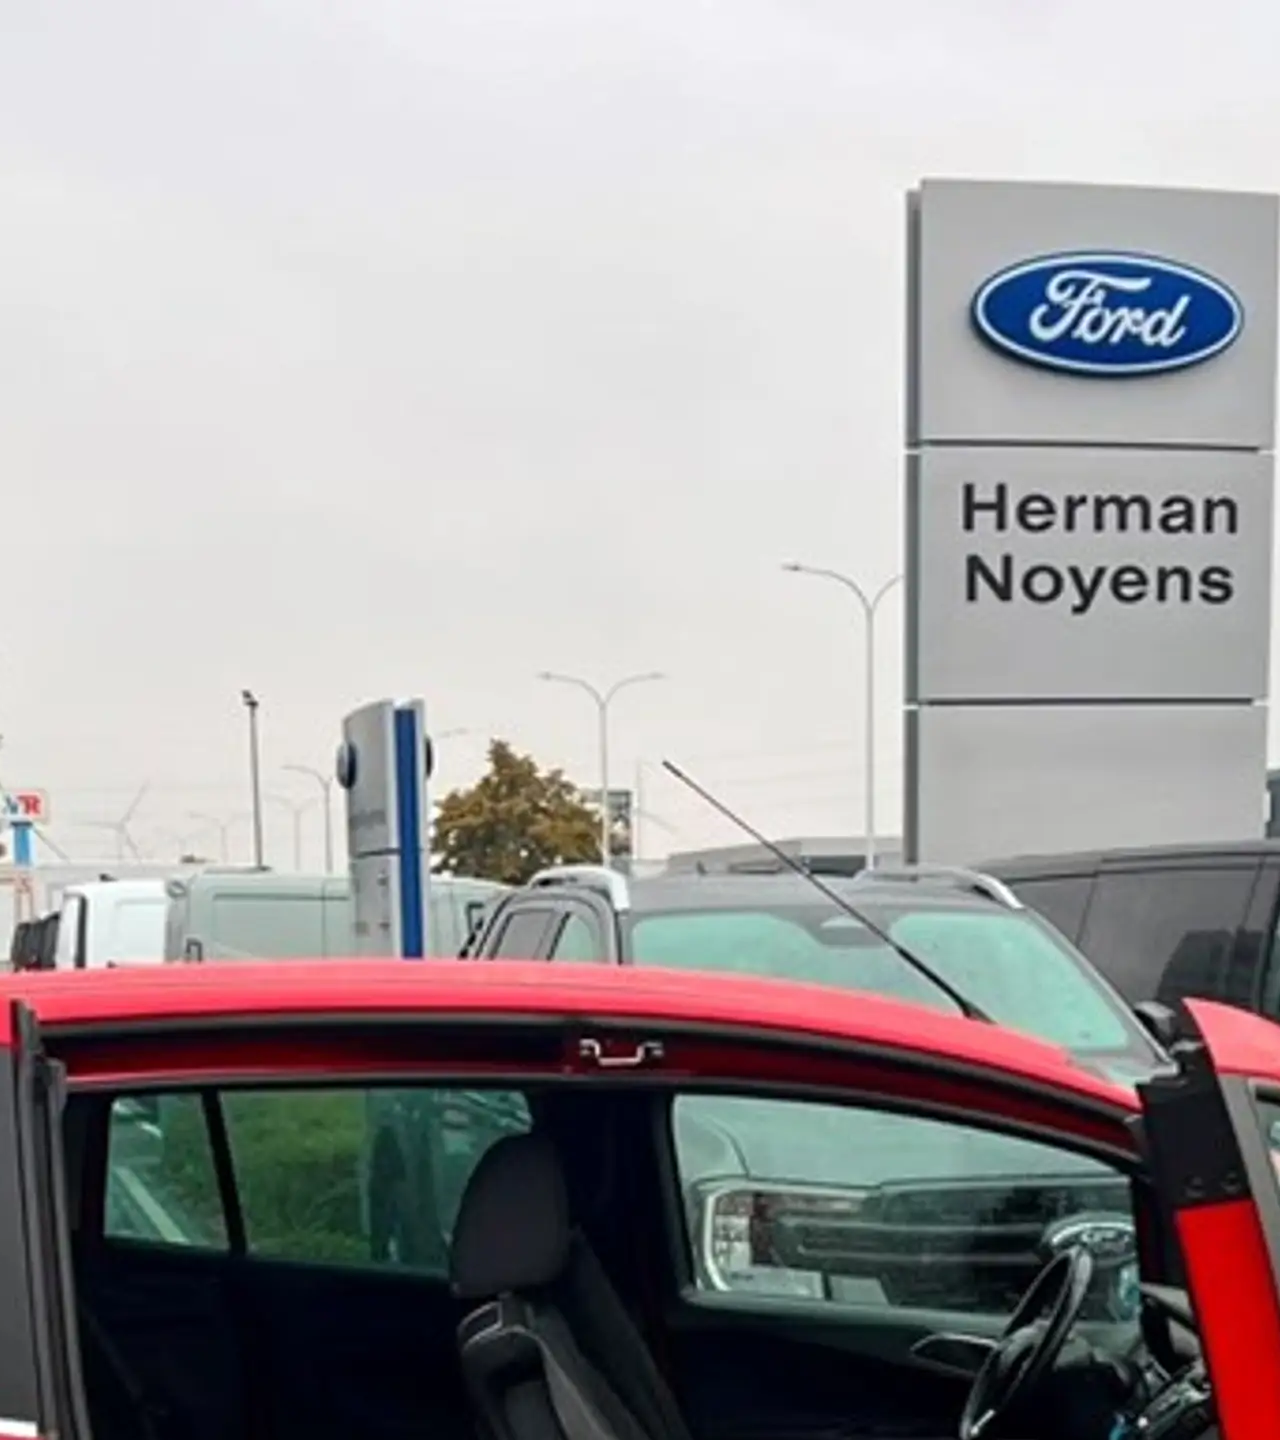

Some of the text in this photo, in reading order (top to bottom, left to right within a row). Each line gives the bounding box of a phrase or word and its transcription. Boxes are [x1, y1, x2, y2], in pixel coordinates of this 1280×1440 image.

[1029, 269, 1191, 347] Ford
[961, 482, 1238, 534] Herman
[965, 553, 1234, 616] Noyens
